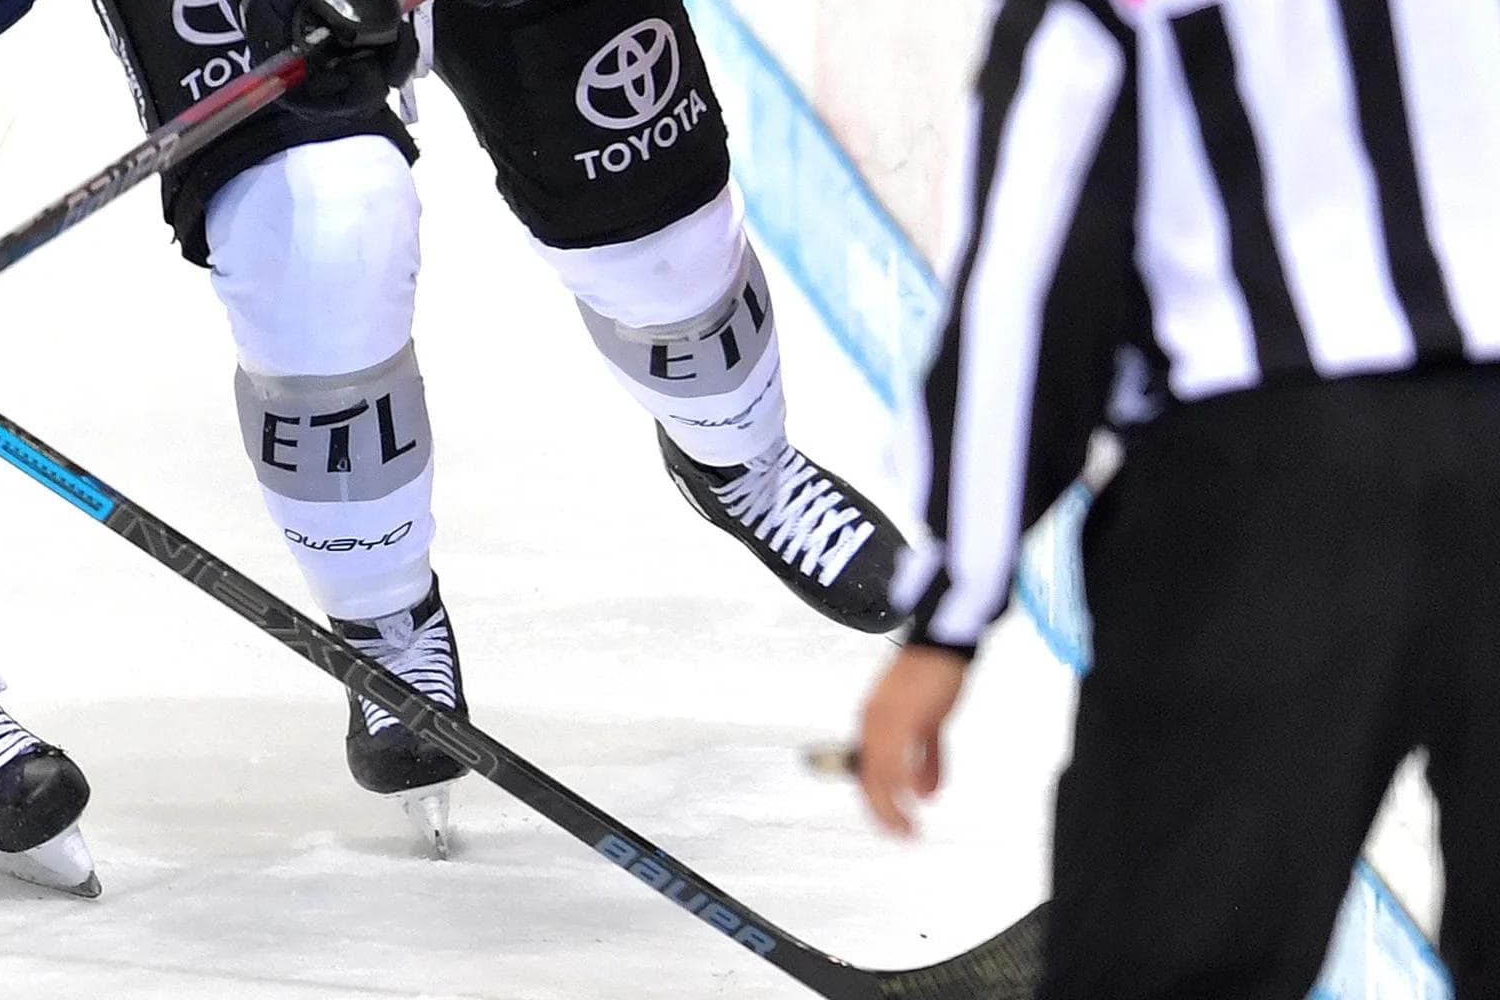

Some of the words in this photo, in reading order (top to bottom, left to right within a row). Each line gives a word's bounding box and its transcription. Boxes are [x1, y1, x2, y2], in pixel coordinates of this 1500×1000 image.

[180, 45, 252, 102] TOY
[574, 88, 708, 180] TOYOTA
[262, 393, 417, 473] ETL
[284, 520, 414, 552] owayo
[595, 833, 778, 958] BAUER
